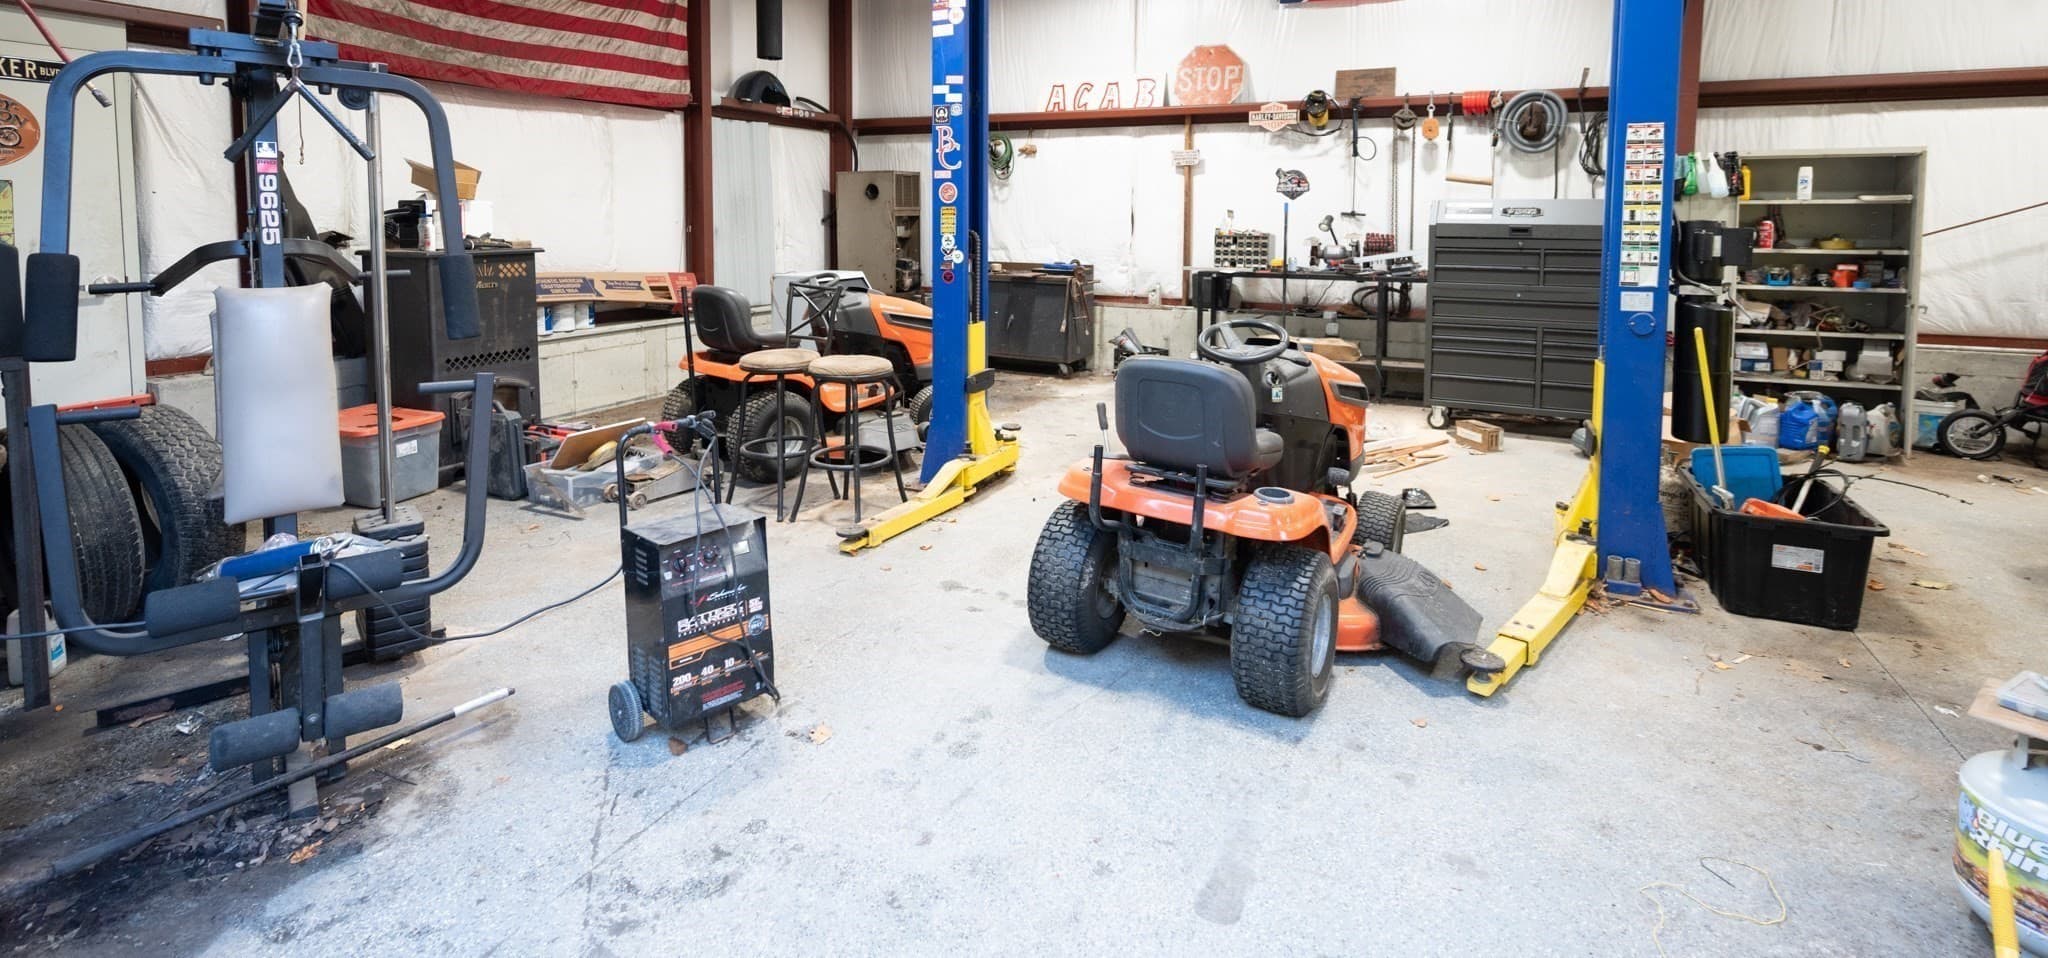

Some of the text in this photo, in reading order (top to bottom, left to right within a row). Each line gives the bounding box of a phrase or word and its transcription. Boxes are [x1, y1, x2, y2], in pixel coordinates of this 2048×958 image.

[1178, 65, 1243, 93] STOP
[259, 174, 281, 245] 9625
[672, 672, 692, 687] 200
[700, 664, 714, 677] 40
[724, 657, 735, 668] 10
[1977, 807, 2048, 859] Blue
